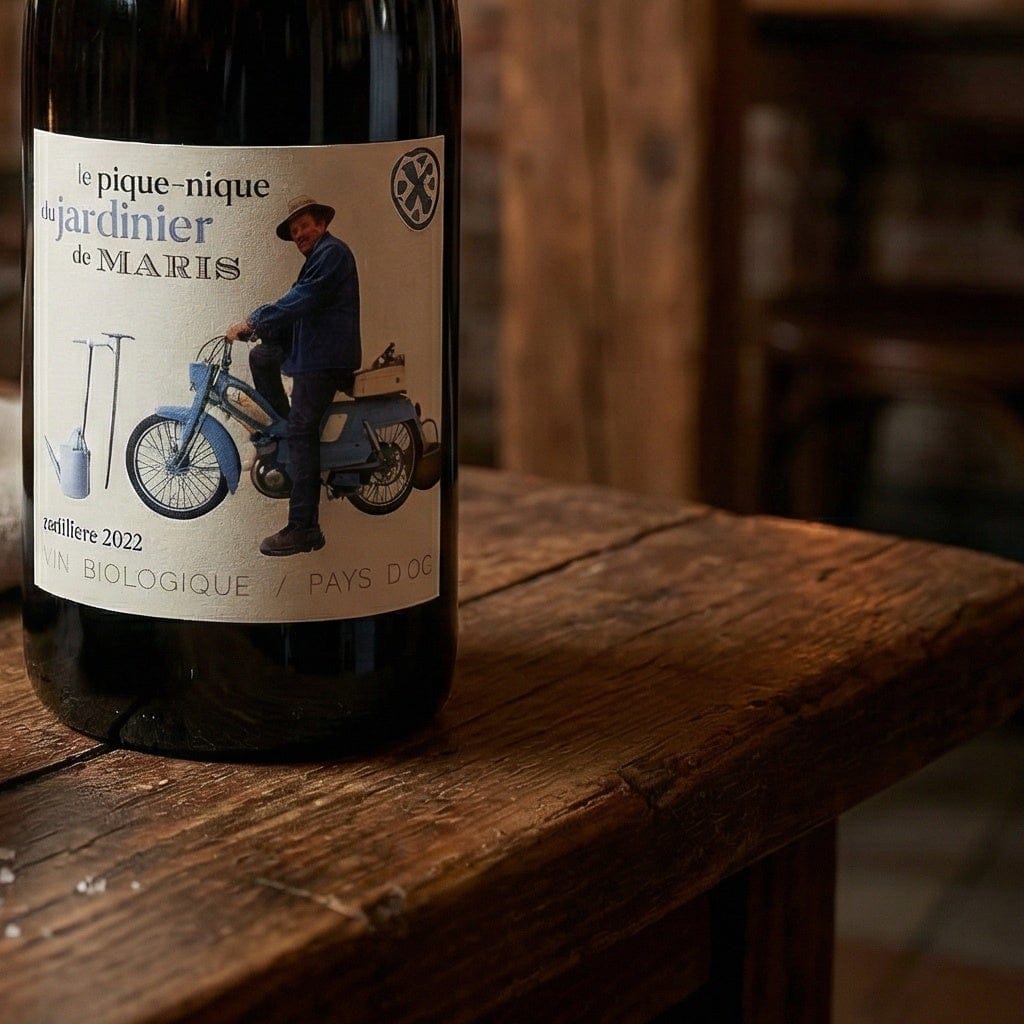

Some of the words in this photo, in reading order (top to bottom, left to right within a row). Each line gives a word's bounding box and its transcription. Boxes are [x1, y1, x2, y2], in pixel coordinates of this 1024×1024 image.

[77, 162, 92, 186] le
[97, 166, 270, 207] pique-nique
[41, 200, 55, 222] du
[55, 195, 214, 244] jardinier
[72, 244, 91, 266] de
[96, 247, 240, 281] MARIS
[102, 528, 143, 552] 2022
[42, 544, 70, 574] VIN
[84, 558, 251, 597] BIOLOGIQUE
[309, 567, 372, 595] PAYS
